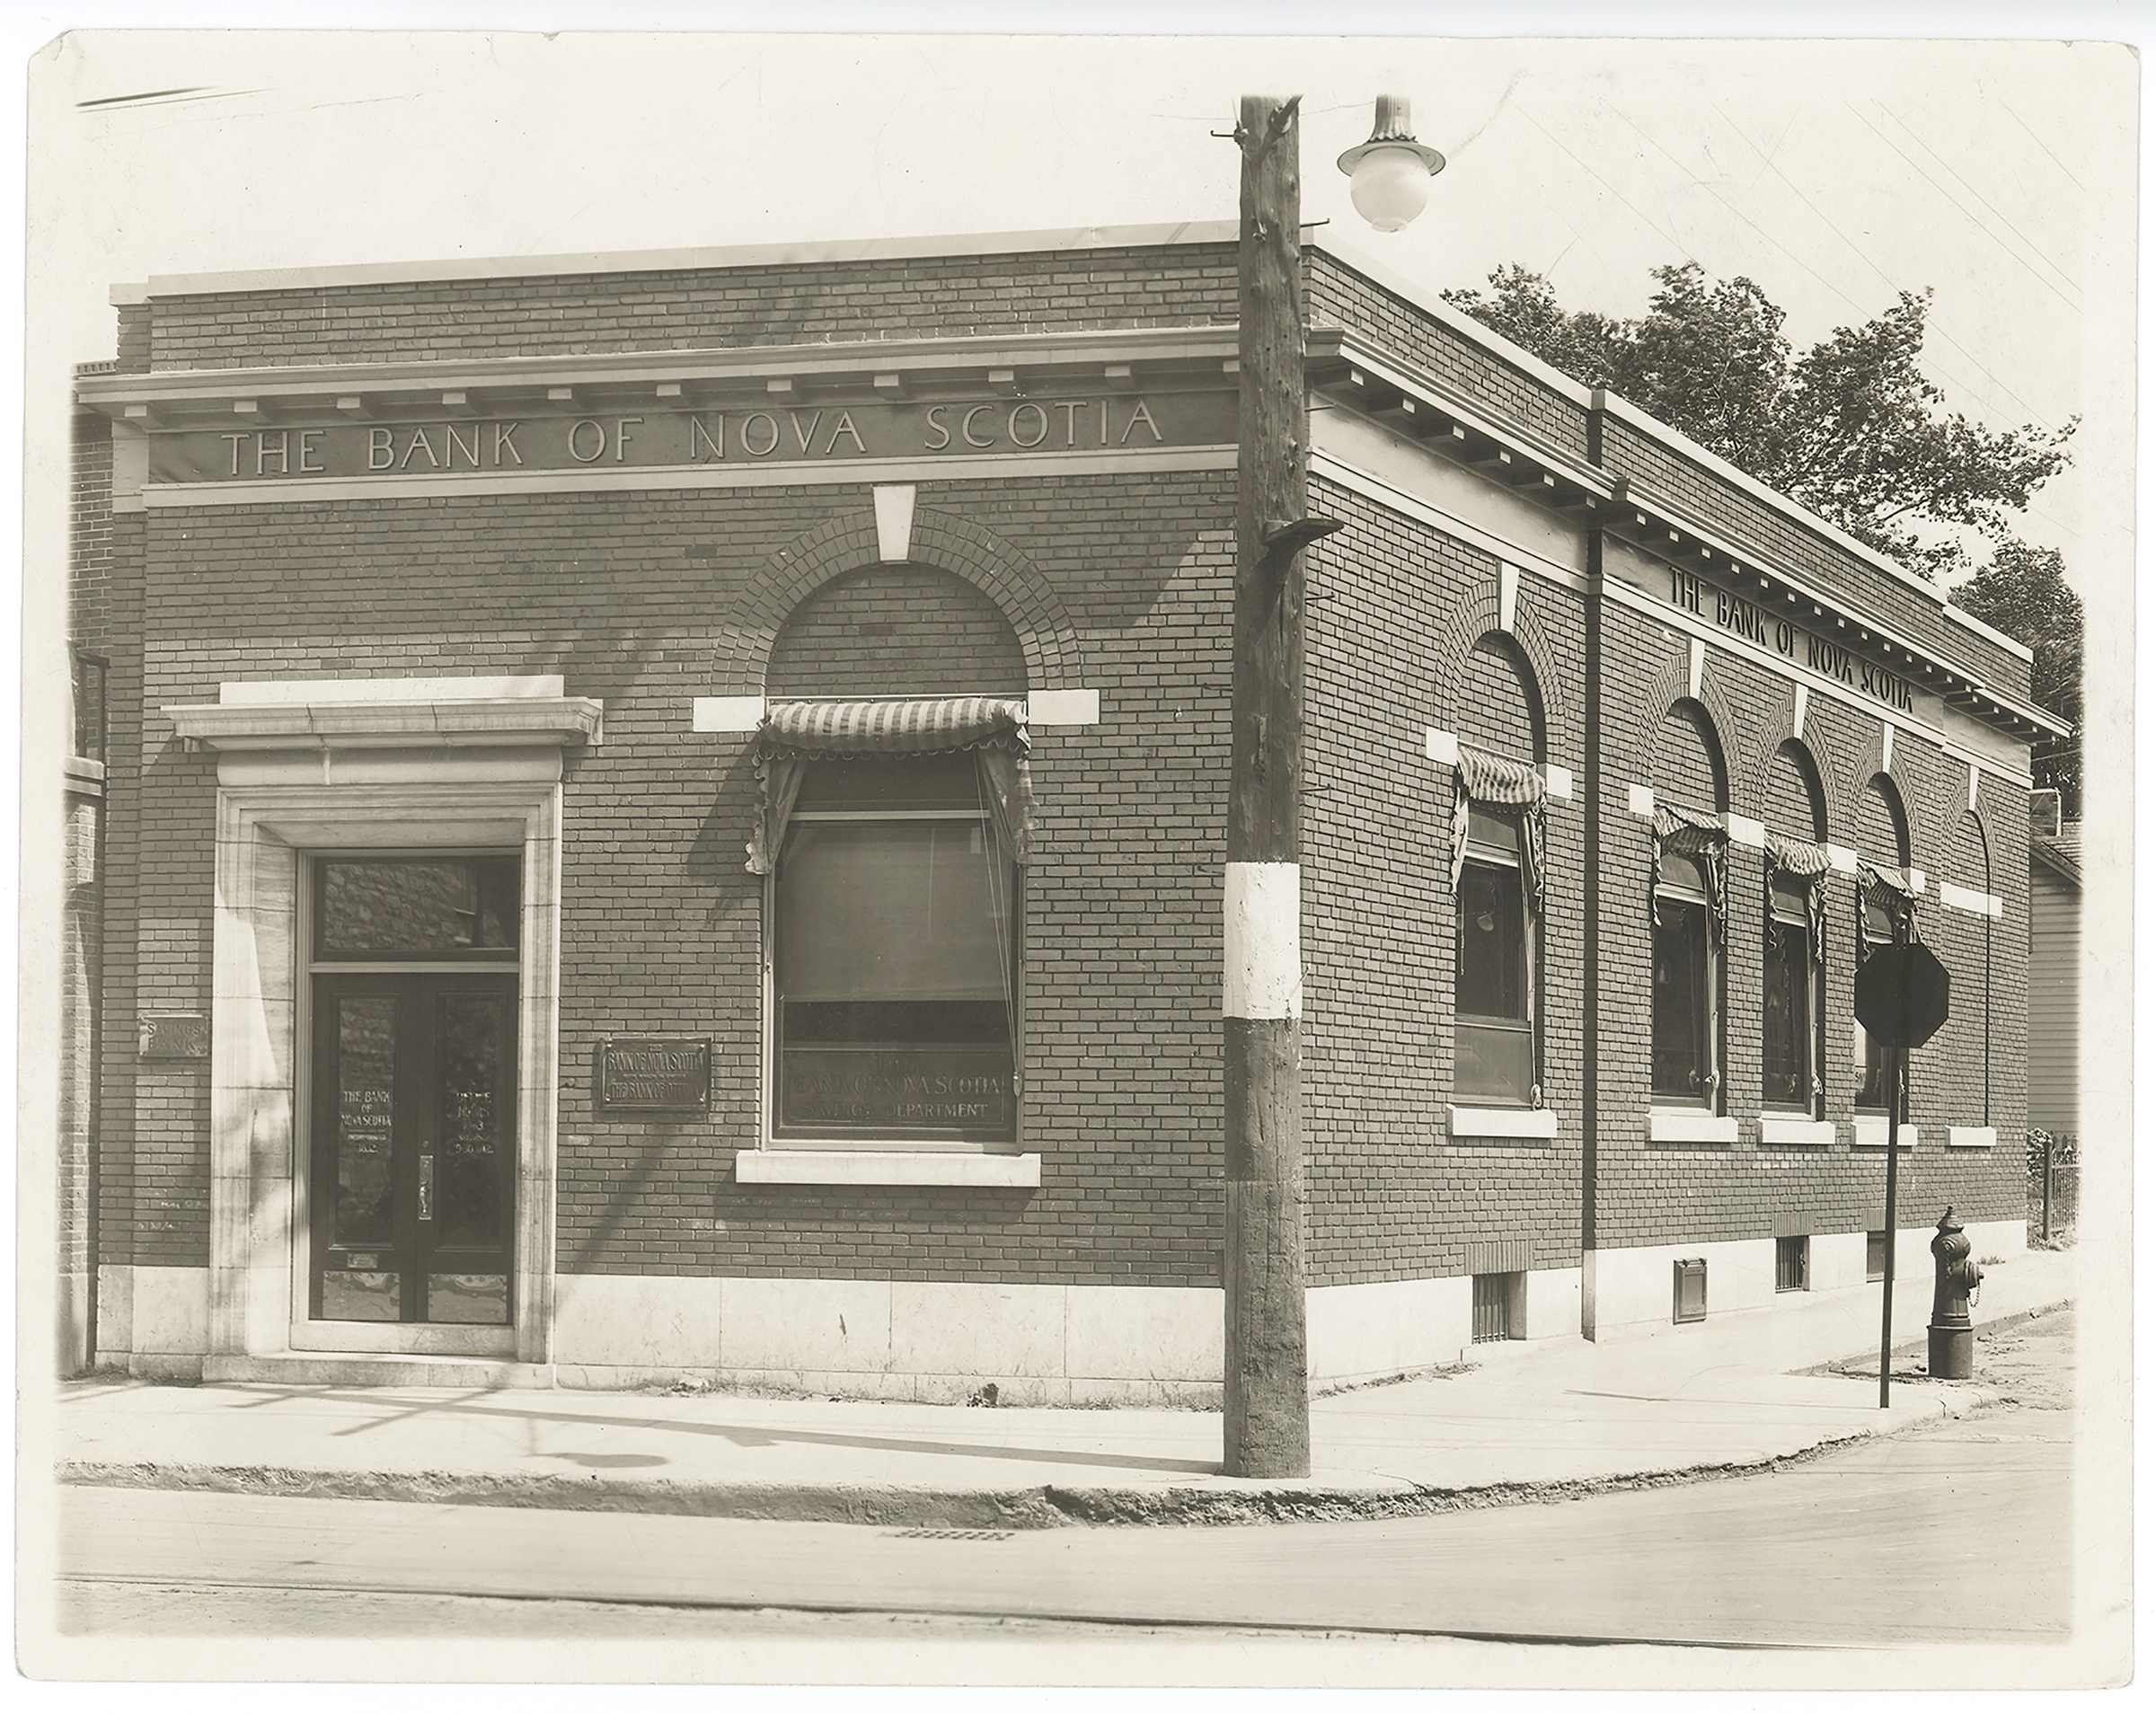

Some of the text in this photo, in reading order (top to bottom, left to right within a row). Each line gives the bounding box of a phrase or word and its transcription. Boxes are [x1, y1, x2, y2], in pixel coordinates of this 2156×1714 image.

[221, 400, 1164, 476] THE BANK OF NOVA SCOTIA
[1669, 566, 1913, 714] THE BANK OF NOVA SCOTIA
[147, 1022, 202, 1037] SAVINGS
[148, 1038, 197, 1053] BANK
[608, 1052, 634, 1071] BANK
[634, 1052, 647, 1071] OF
[647, 1052, 670, 1071] NOVA
[611, 1082, 628, 1099] THE
[629, 1082, 653, 1099] BANK
[653, 1082, 665, 1099] OF
[883, 1075, 930, 1095] NOVA
[934, 1076, 1002, 1095] SCOTIA
[343, 1091, 391, 1103] THE BANK
[360, 1104, 373, 1114] OF
[886, 1102, 989, 1118] DEPARTMENT
[340, 1114, 393, 1126] NOVA SCOTIA
